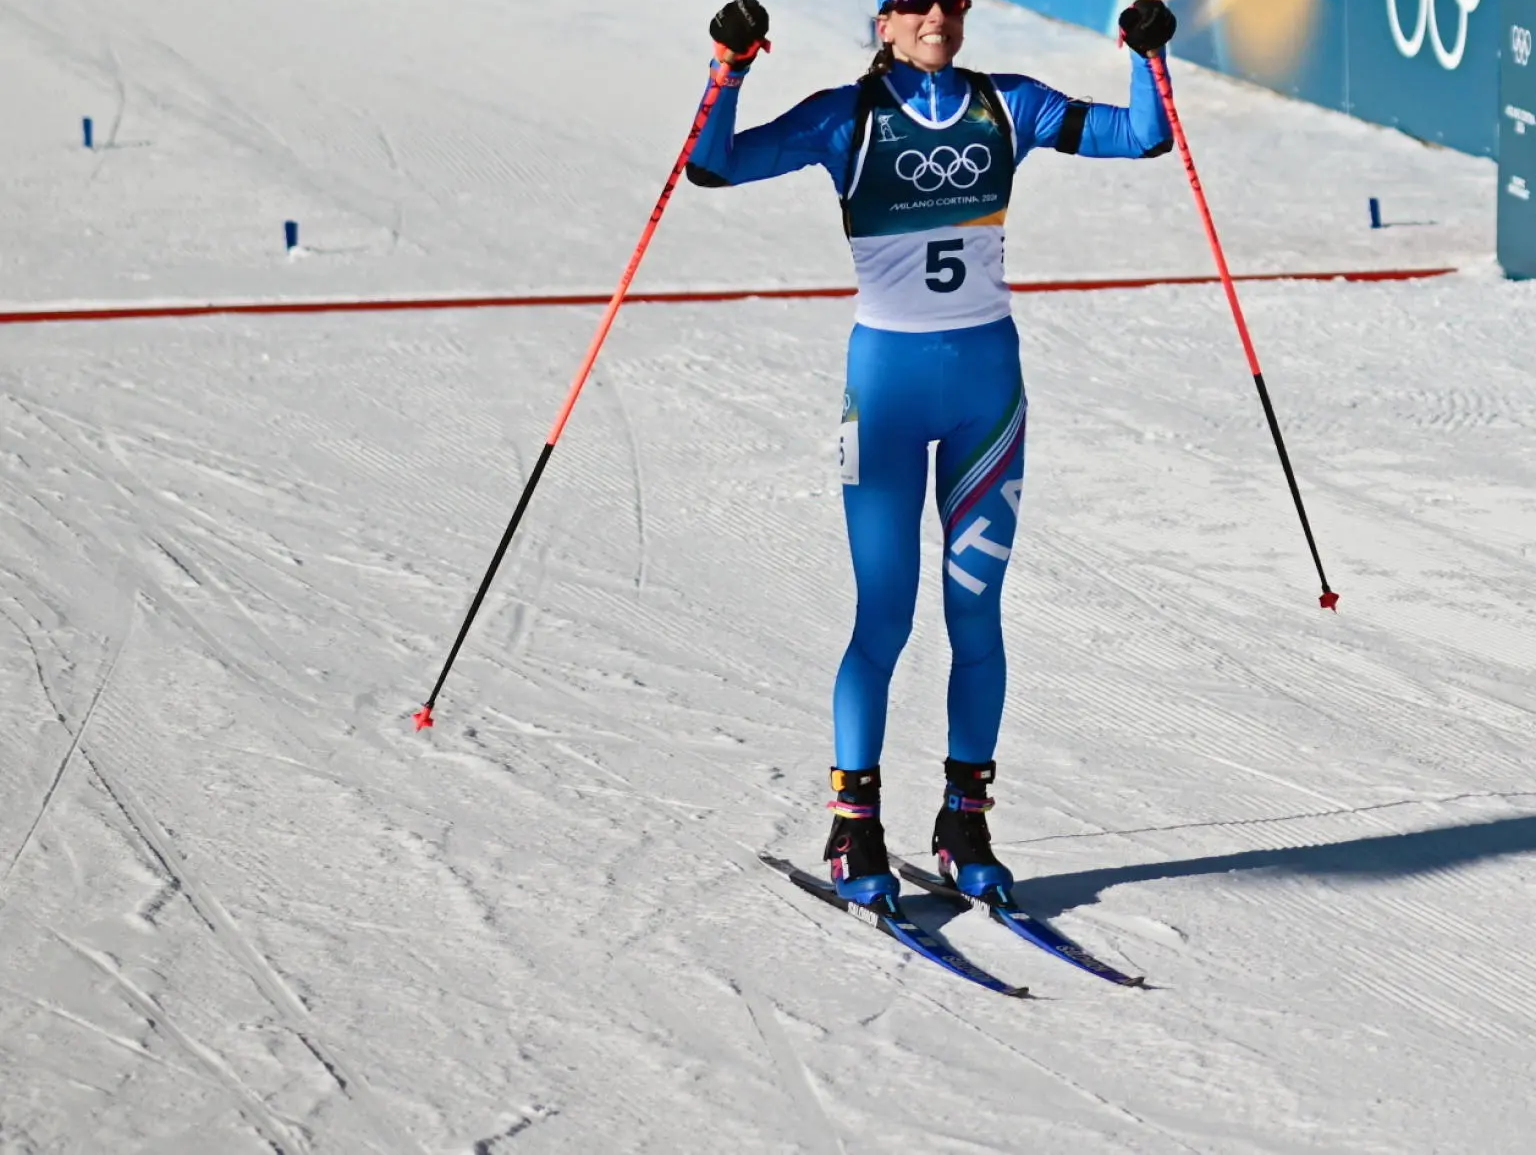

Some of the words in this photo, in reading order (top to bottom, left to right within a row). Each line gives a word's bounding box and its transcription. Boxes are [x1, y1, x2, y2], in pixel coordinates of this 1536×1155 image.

[889, 199, 935, 212] MILANO
[936, 194, 979, 207] CORTINA
[924, 238, 967, 294] 5
